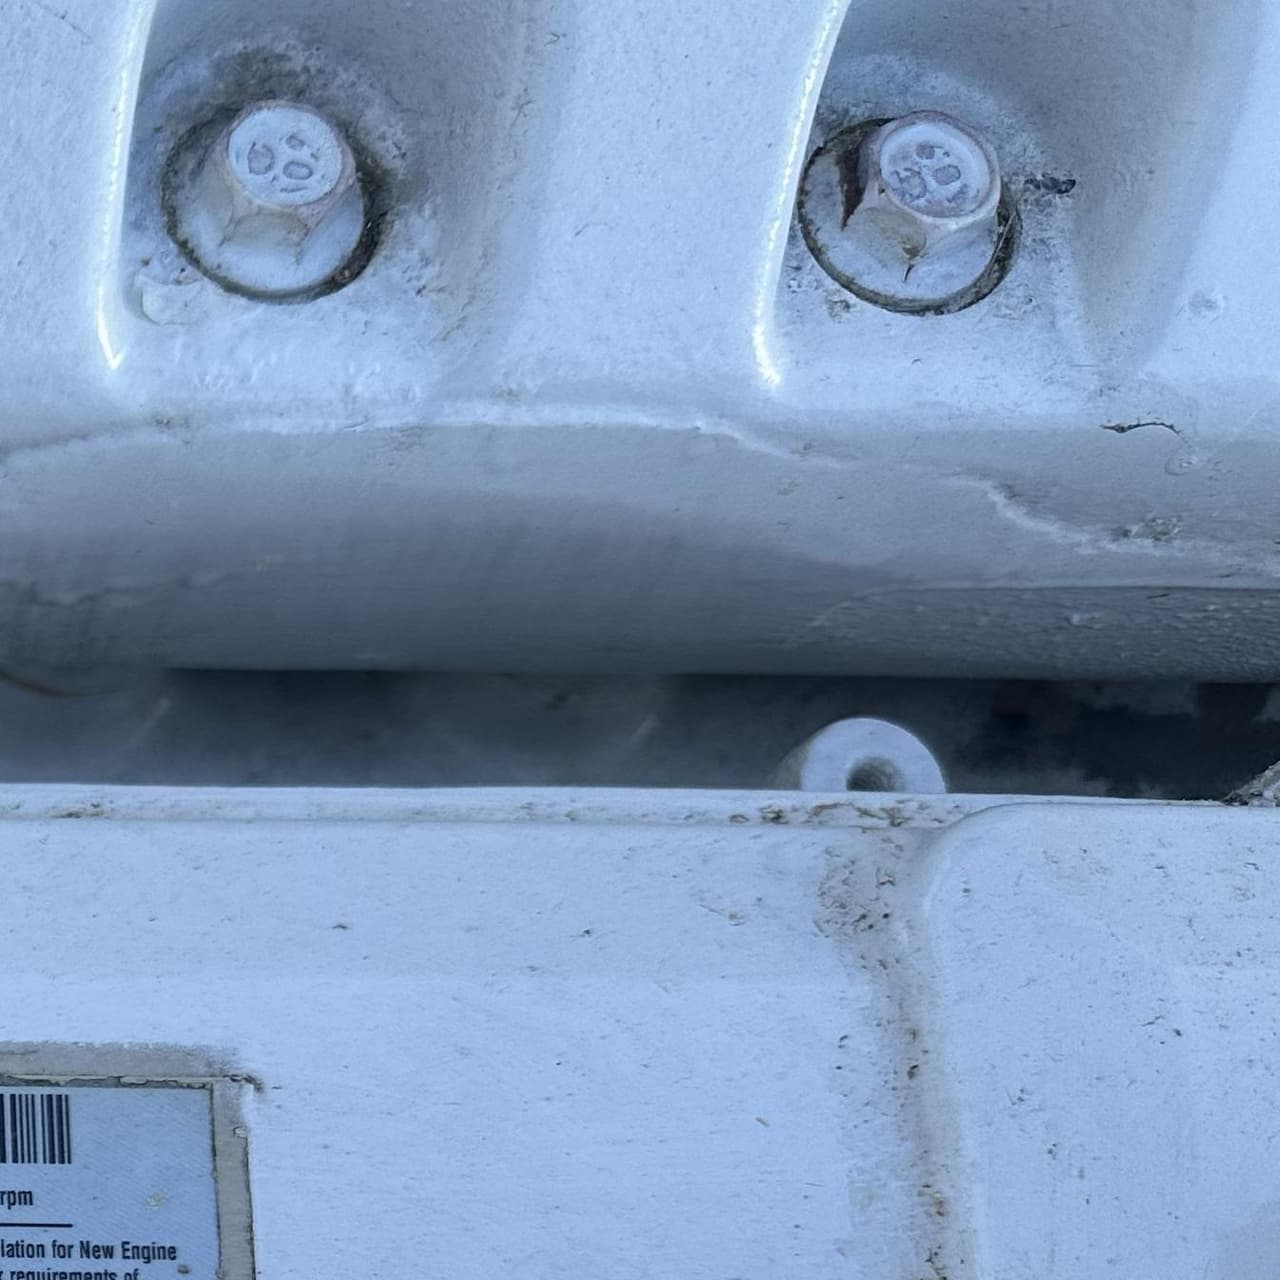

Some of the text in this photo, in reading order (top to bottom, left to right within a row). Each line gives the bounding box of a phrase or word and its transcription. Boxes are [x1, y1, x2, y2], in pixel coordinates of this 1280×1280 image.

[0, 1190, 34, 1210] rpm
[51, 1239, 74, 1259] for
[79, 1240, 114, 1260] New
[121, 1241, 177, 1264] Engine
